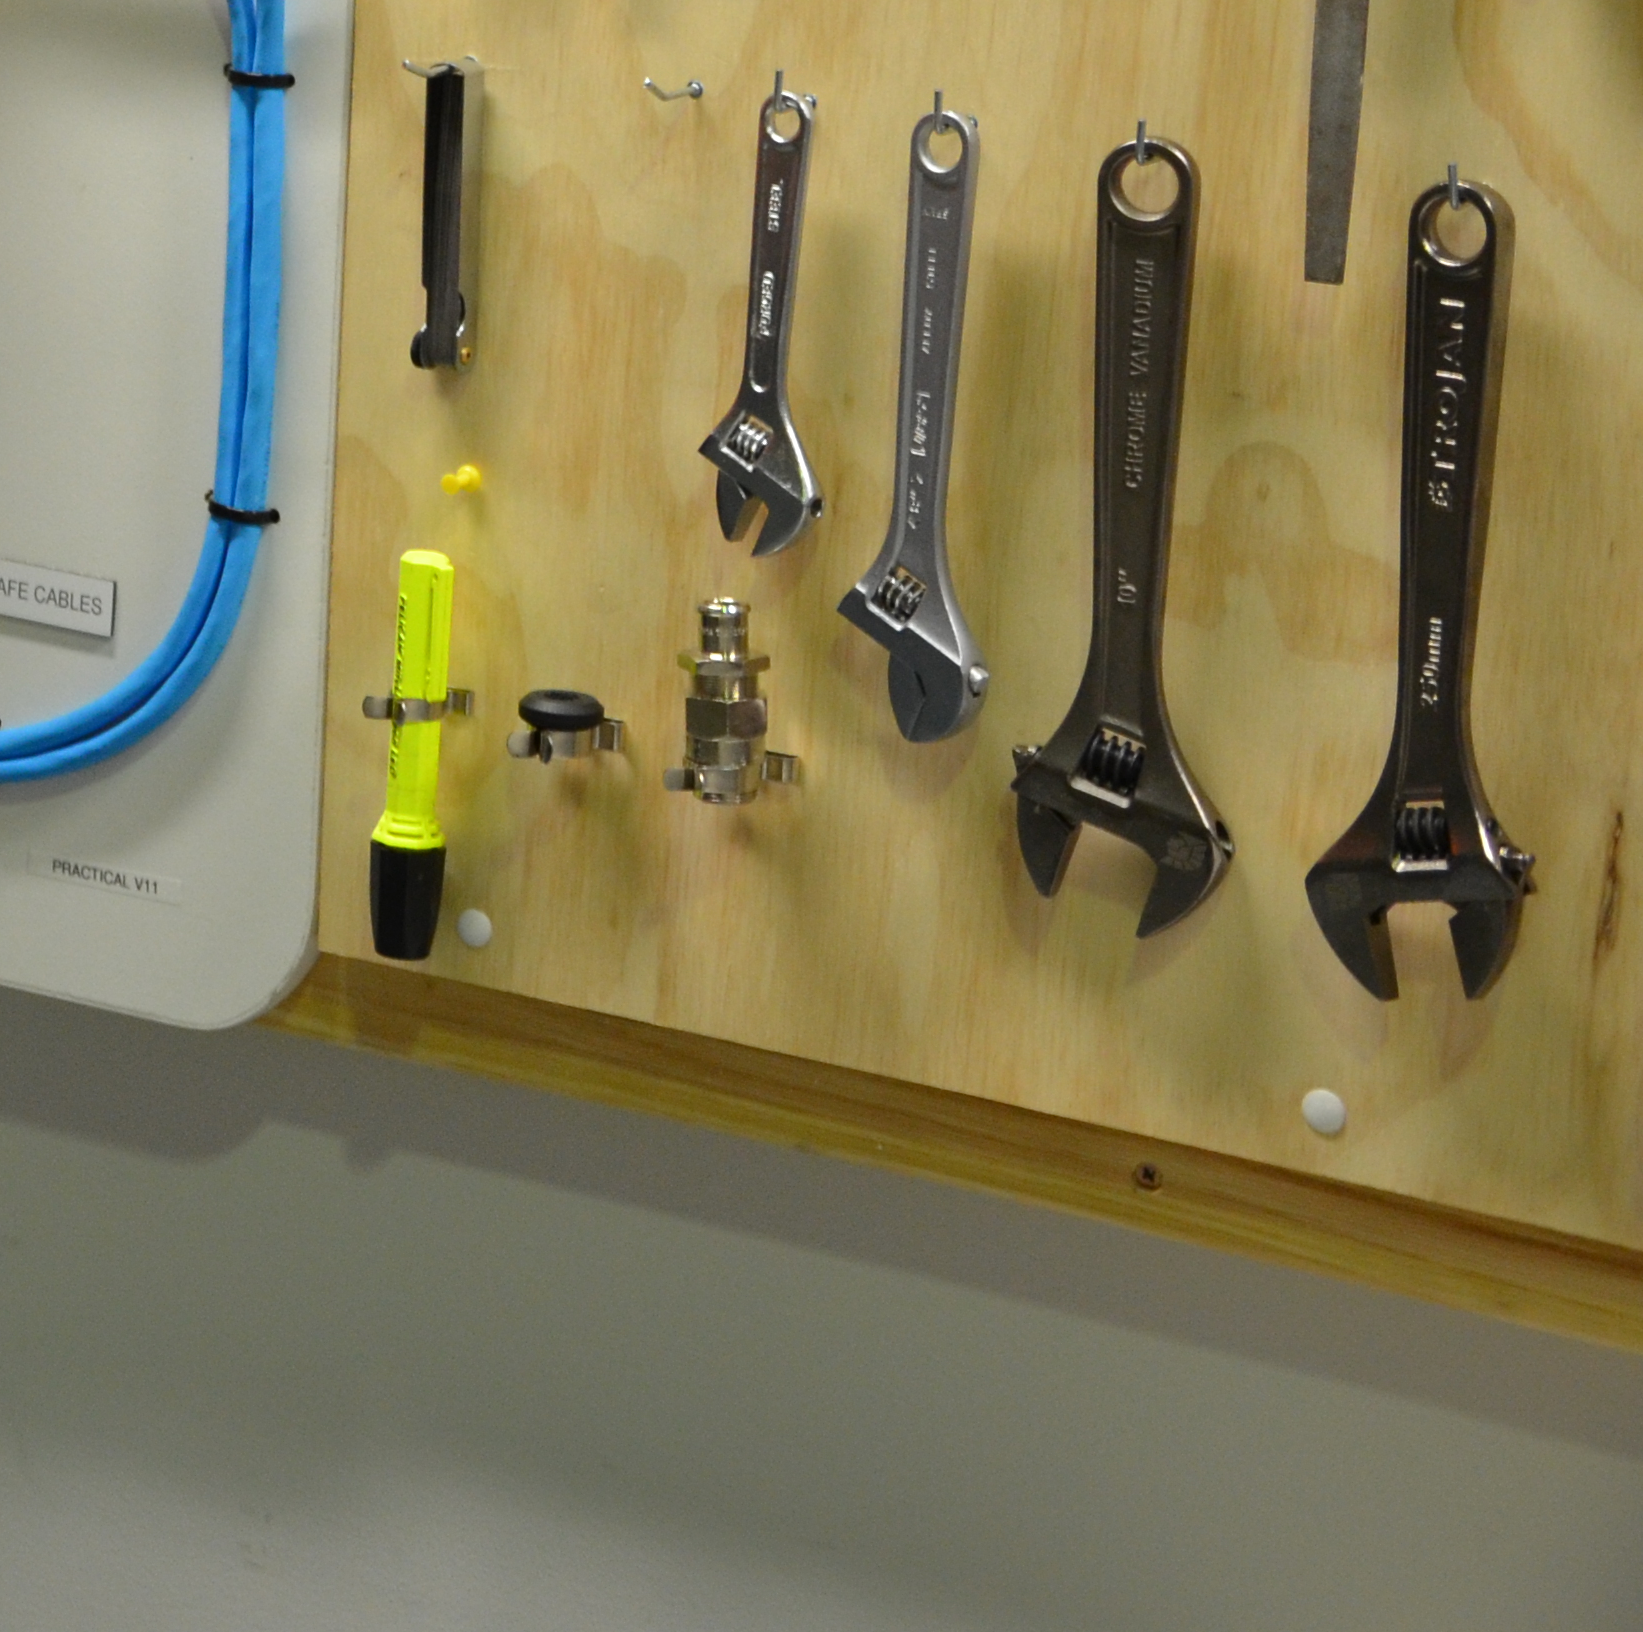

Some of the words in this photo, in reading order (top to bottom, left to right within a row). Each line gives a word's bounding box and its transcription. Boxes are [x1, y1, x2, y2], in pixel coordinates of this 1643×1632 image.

[1128, 257, 1154, 376] VANADIUM
[1431, 297, 1467, 474] TROJAN
[1124, 391, 1147, 489] CHROME
[34, 585, 103, 616] CABLES
[51, 858, 131, 890] PRACTICAL
